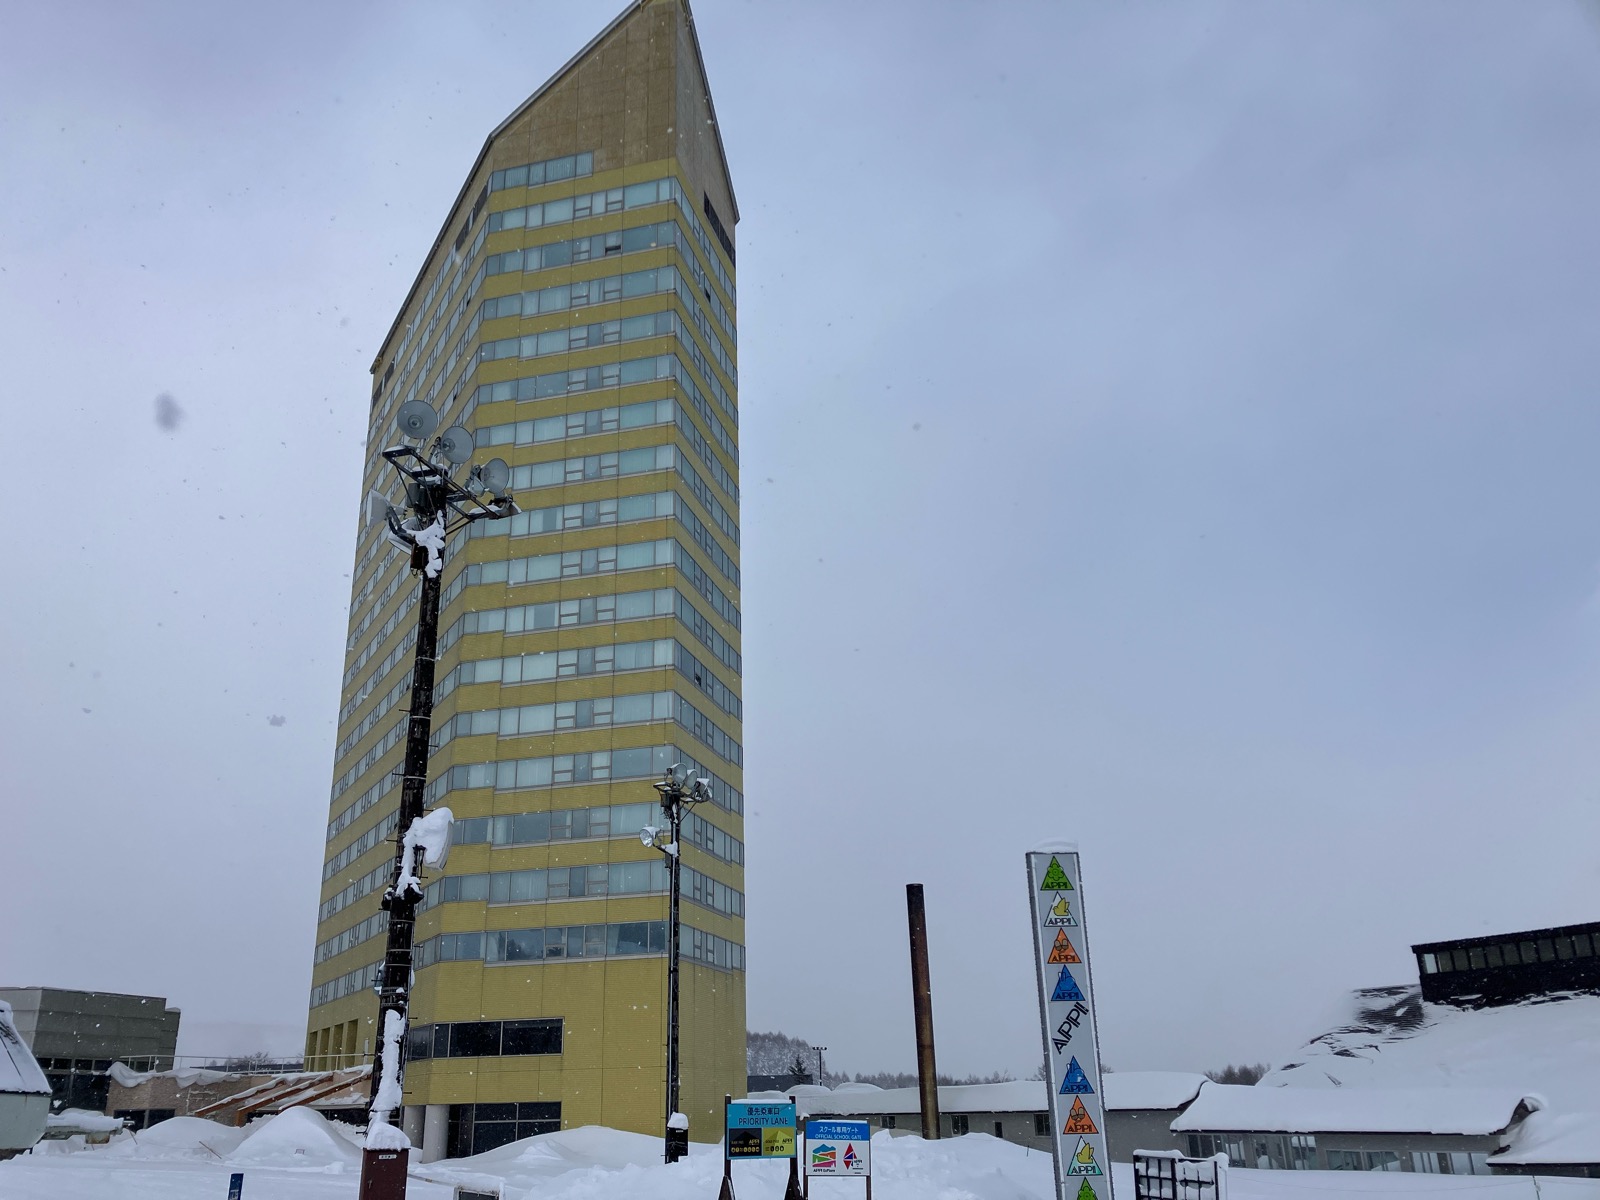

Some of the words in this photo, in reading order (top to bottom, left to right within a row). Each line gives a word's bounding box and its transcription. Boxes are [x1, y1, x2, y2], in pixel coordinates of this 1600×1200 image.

[1052, 1002, 1089, 1054] APPI
[771, 1117, 788, 1125] LANE
[819, 1126, 859, 1134] スクール専用ゲート
[1071, 1166, 1096, 1174] APPI
